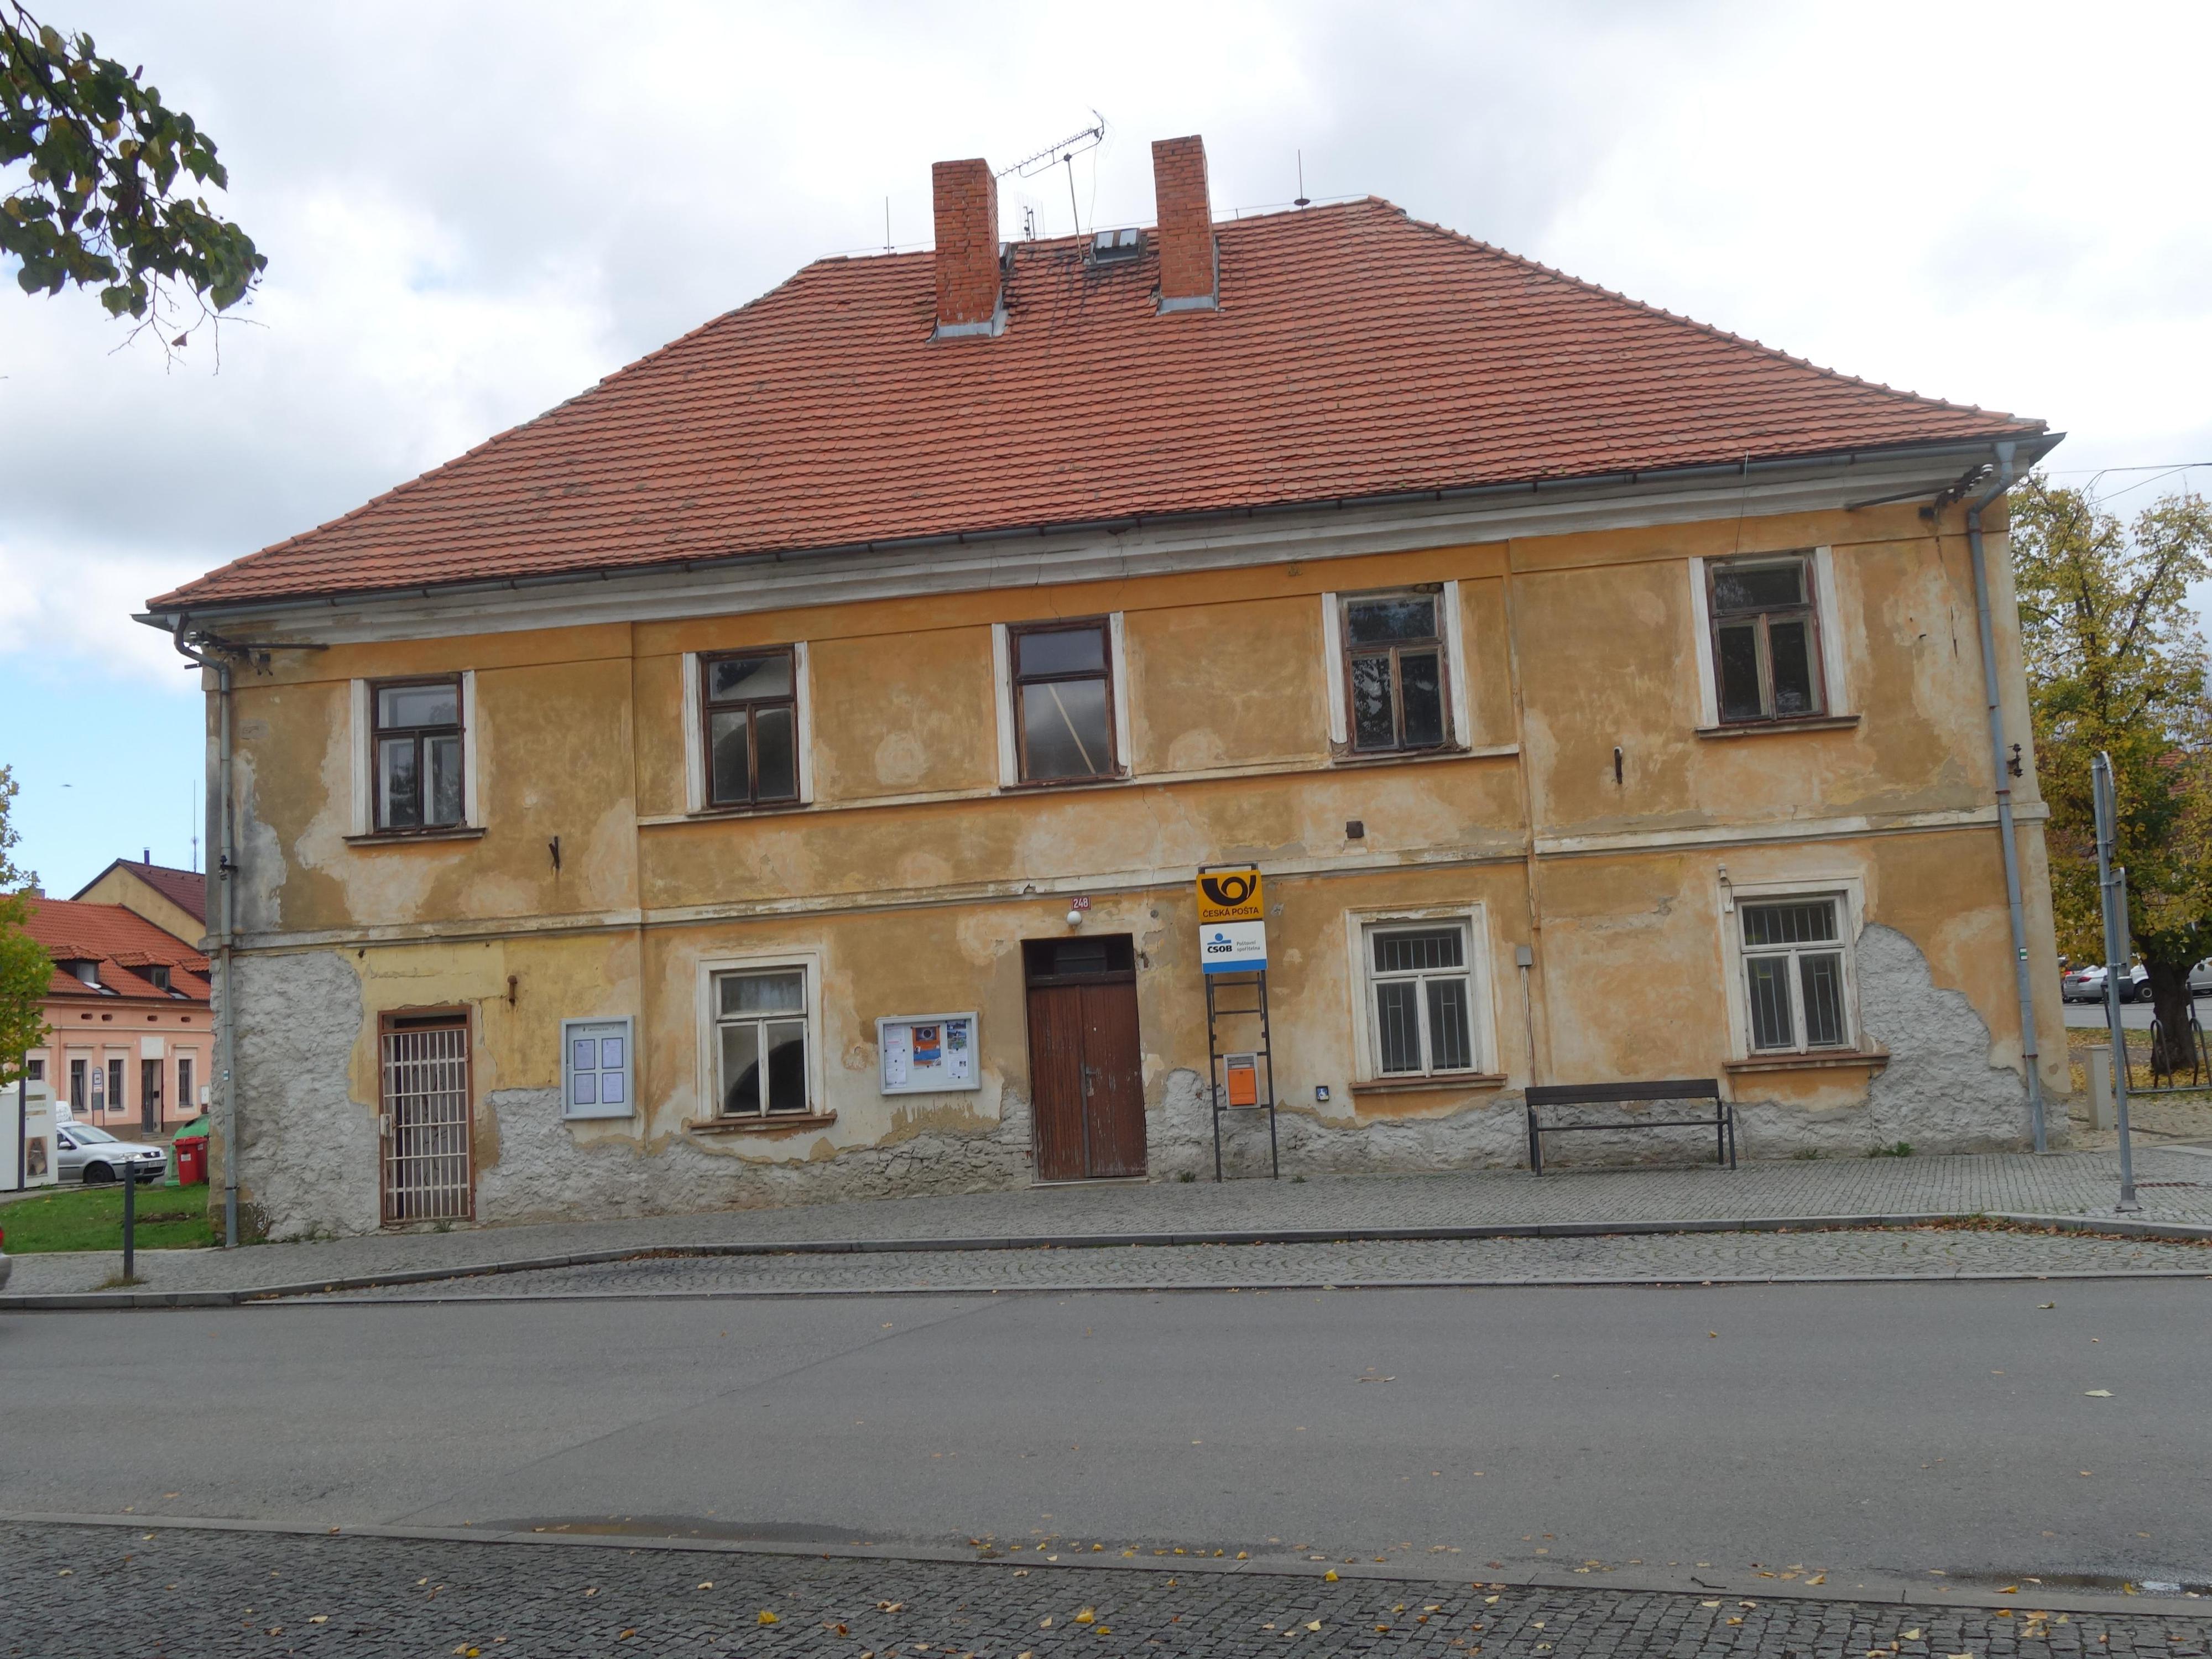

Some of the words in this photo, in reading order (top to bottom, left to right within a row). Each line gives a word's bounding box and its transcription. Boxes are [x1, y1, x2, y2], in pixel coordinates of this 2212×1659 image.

[1073, 898, 1088, 909] 248
[1203, 907, 1230, 917] ČESKÁ
[1232, 906, 1259, 915] POŠTA
